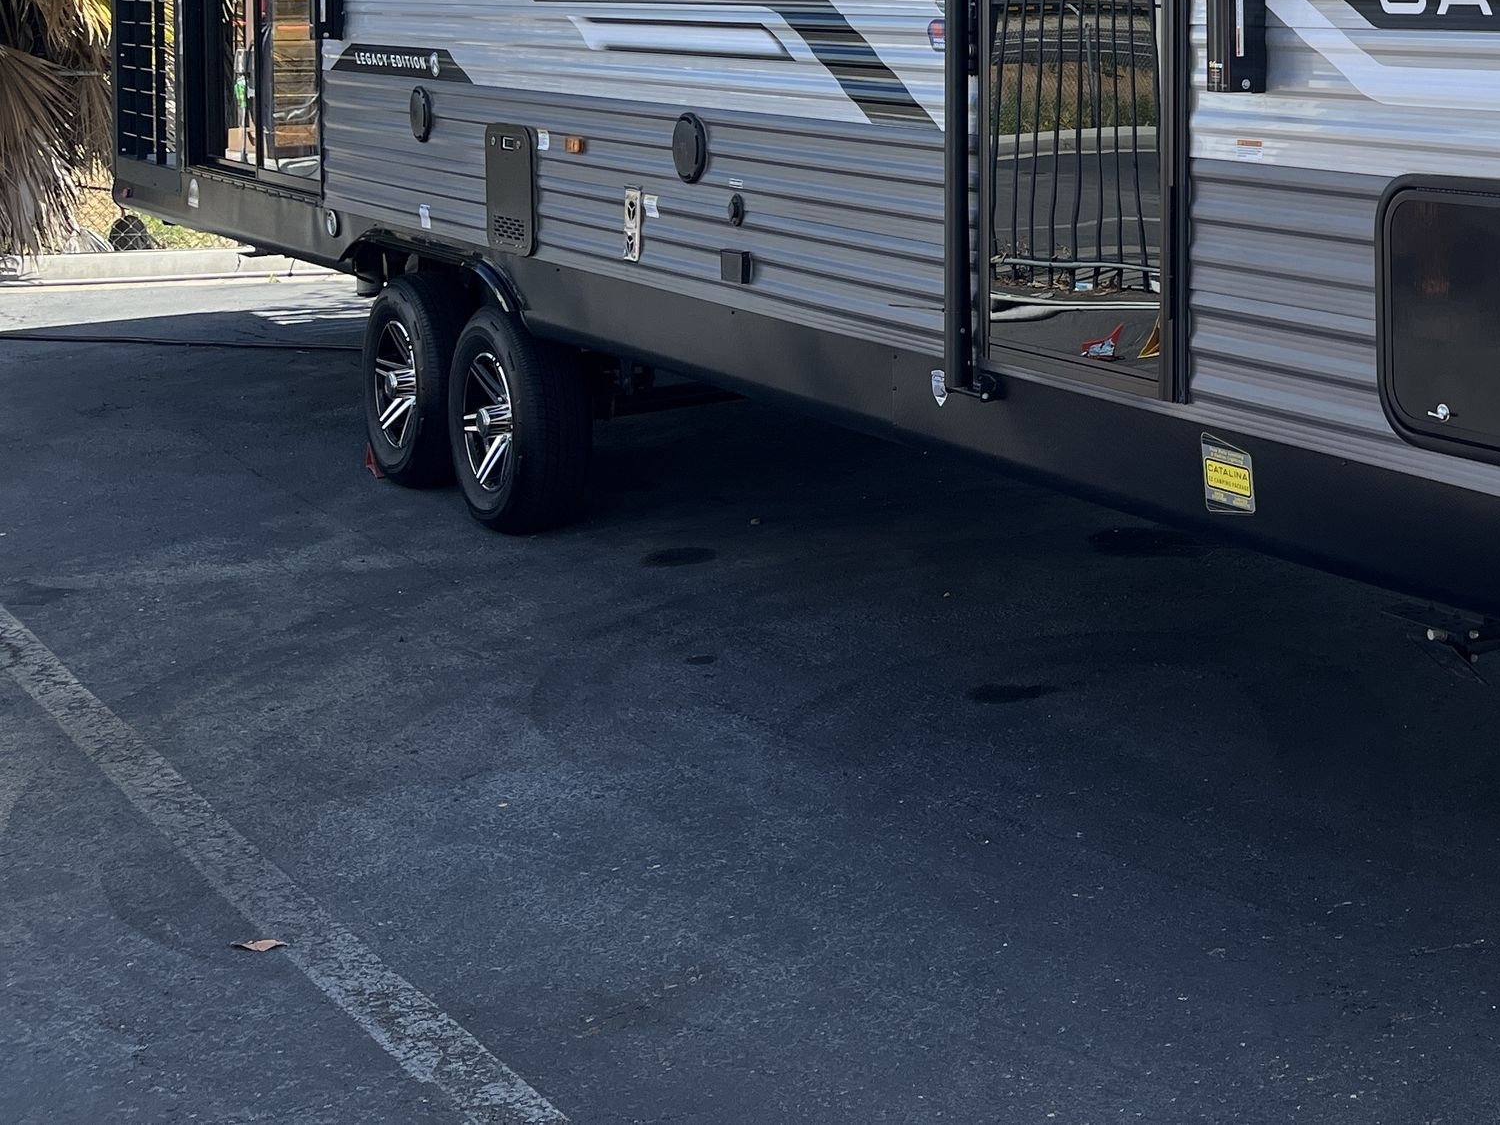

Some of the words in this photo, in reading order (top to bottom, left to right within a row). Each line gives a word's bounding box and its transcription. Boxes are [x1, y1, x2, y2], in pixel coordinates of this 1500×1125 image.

[354, 51, 388, 67] LEGACY
[390, 54, 427, 70] EDITION
[1207, 463, 1249, 481] CATALINA
